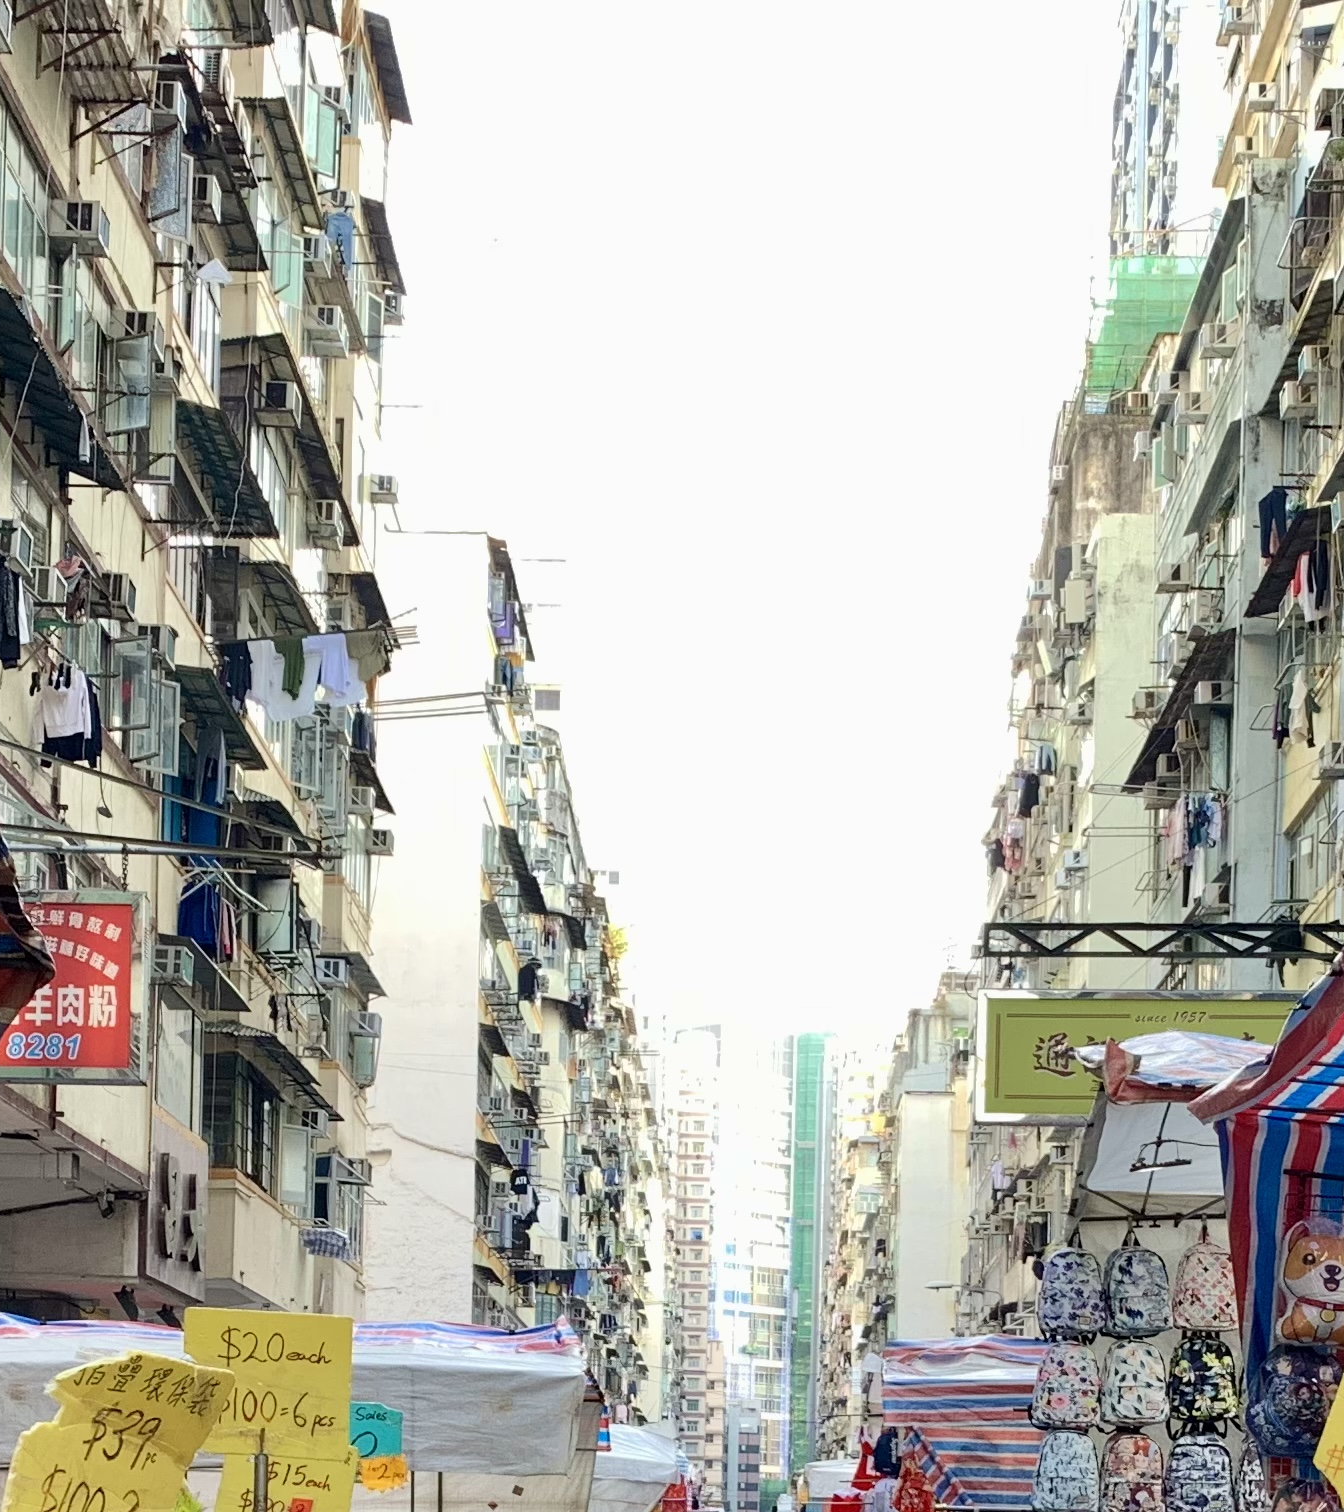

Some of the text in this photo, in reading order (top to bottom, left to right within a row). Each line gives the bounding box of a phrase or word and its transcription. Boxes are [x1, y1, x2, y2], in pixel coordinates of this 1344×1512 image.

[11, 984, 118, 1029] 羊肉粉
[1173, 1011, 1207, 1024] 1957
